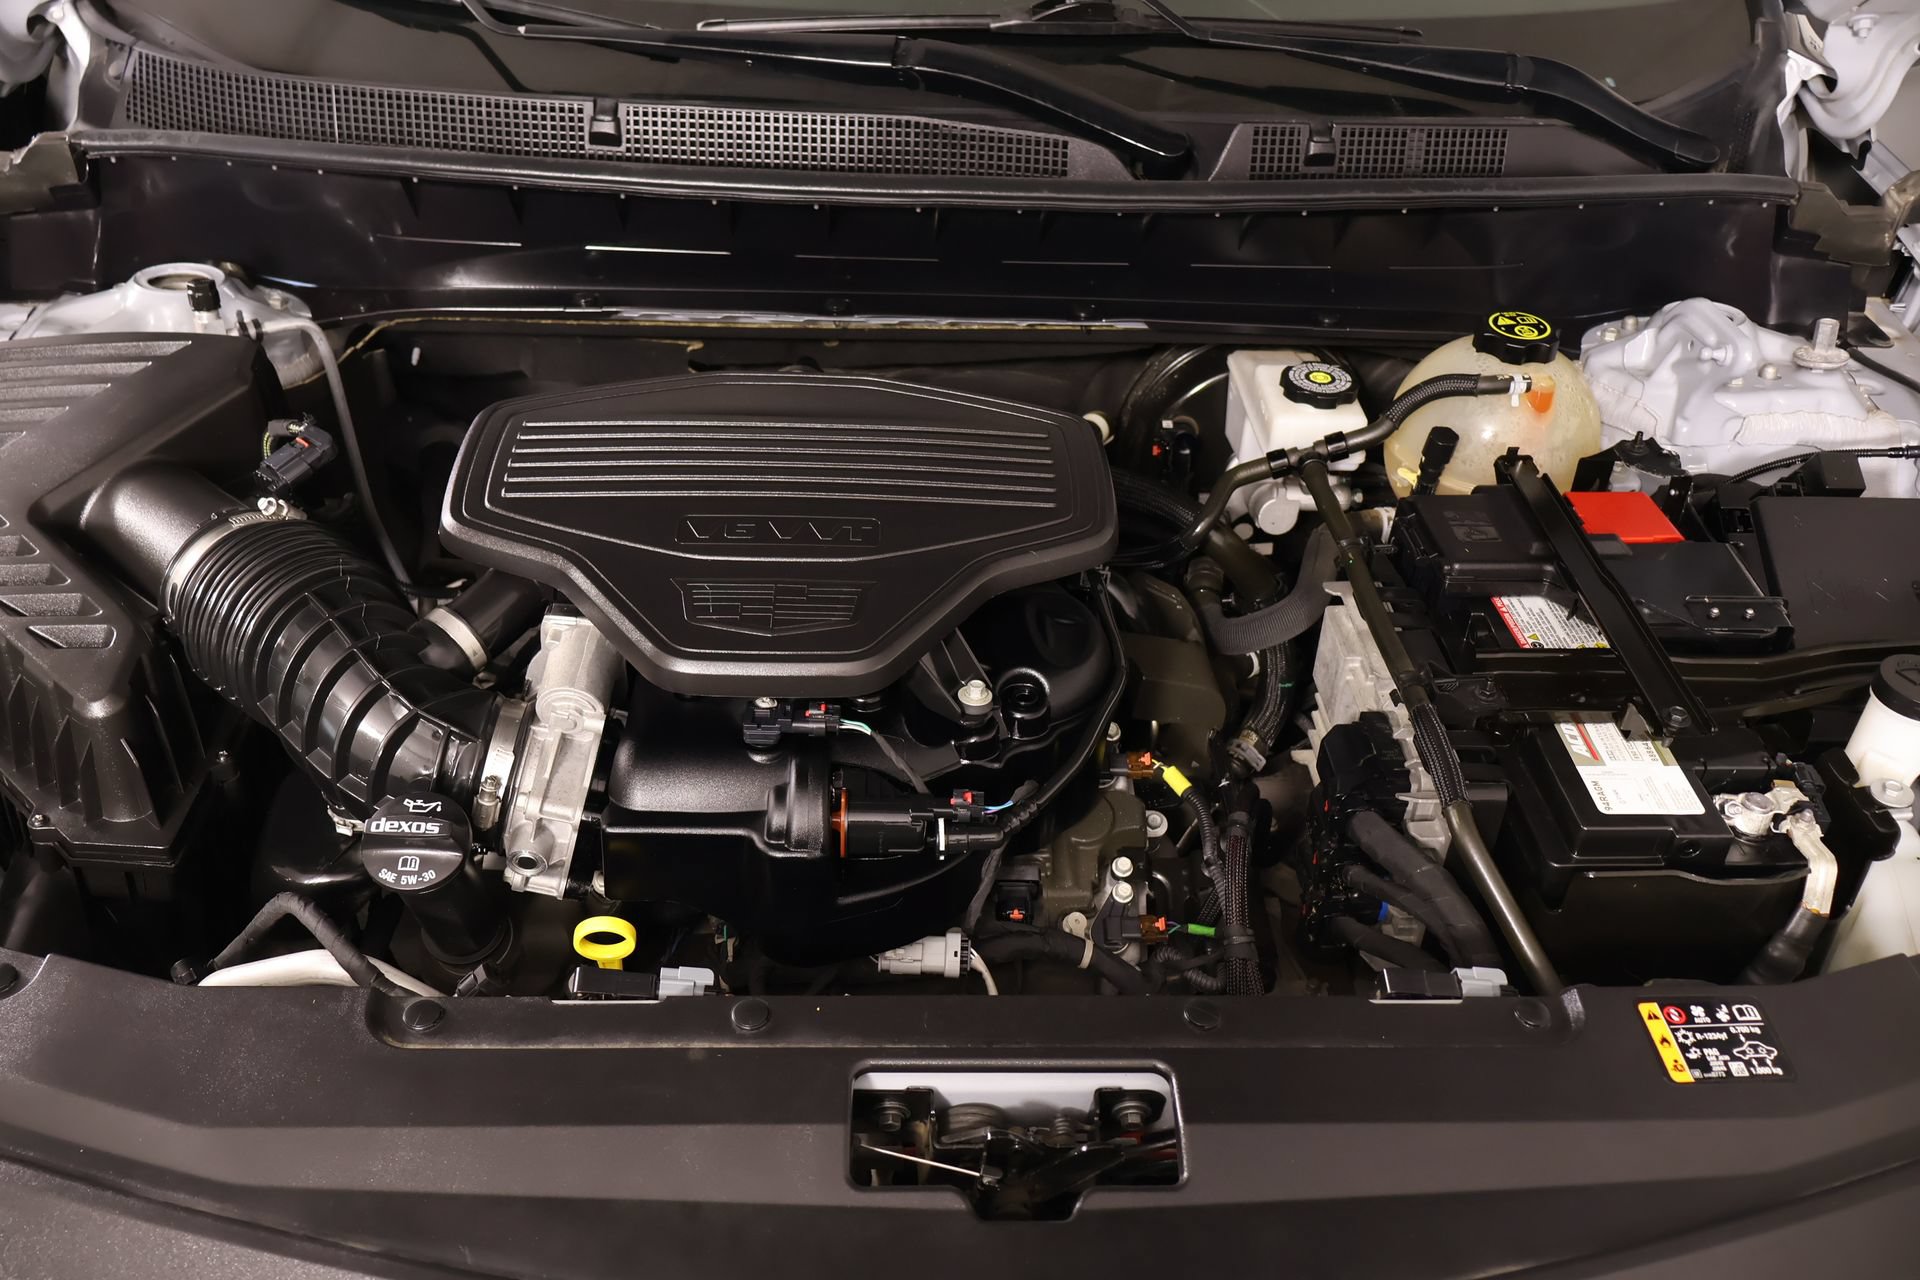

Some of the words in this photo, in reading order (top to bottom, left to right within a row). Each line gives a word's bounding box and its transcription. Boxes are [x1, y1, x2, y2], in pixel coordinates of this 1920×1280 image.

[1641, 742, 1659, 762] 88864
[370, 817, 440, 834] dexos
[378, 868, 397, 882] SAE
[400, 869, 436, 884] 5W-30
[1694, 1016, 1712, 1024] AUTO
[1749, 1025, 1762, 1035] kg
